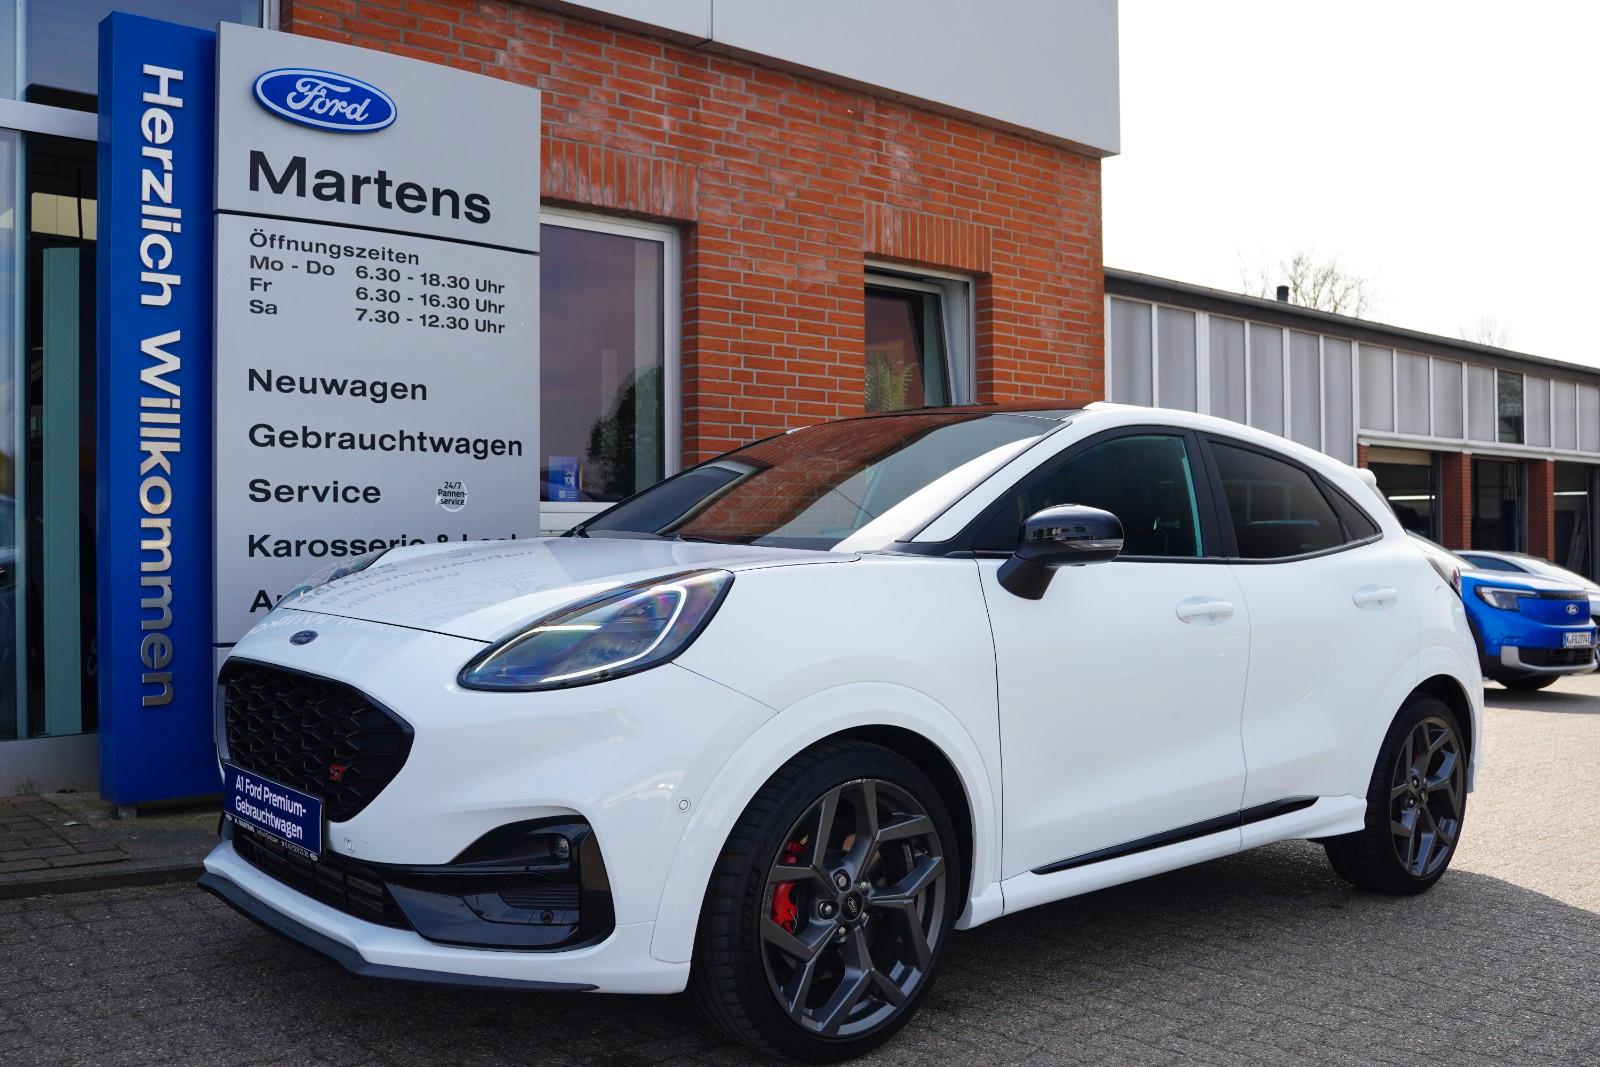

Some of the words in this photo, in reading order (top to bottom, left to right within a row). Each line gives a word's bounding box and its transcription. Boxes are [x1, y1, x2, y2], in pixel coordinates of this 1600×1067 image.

[286, 77, 371, 121] Ford
[140, 63, 184, 307] Herzlich
[249, 149, 491, 225] Martens
[249, 228, 419, 266] Öffnungszeiten
[250, 255, 284, 272] Mo
[306, 260, 335, 276] Do
[355, 265, 401, 283] 6.30
[420, 272, 470, 290] 18.30
[475, 278, 505, 294] Uhr
[250, 277, 273, 292] Fr
[355, 286, 401, 304] 6.30
[420, 293, 470, 311] 16.30
[475, 298, 506, 314] Uhr
[249, 299, 278, 315] Sa
[355, 307, 400, 325] 7.30
[419, 313, 470, 331] 12.30
[475, 318, 506, 334] Uhr
[248, 368, 427, 404] Neuwagen
[248, 423, 523, 461] Gebrauchtwagen
[248, 478, 381, 504] Service
[437, 488, 467, 498] Pannen-
[440, 498, 465, 506] service
[444, 481, 462, 490] 24/7
[140, 329, 181, 707] Willkommen
[235, 774, 244, 792] A1
[245, 778, 263, 801] Ford
[263, 786, 307, 818] Premium-
[235, 795, 303, 840] Gebrauchtwagen
